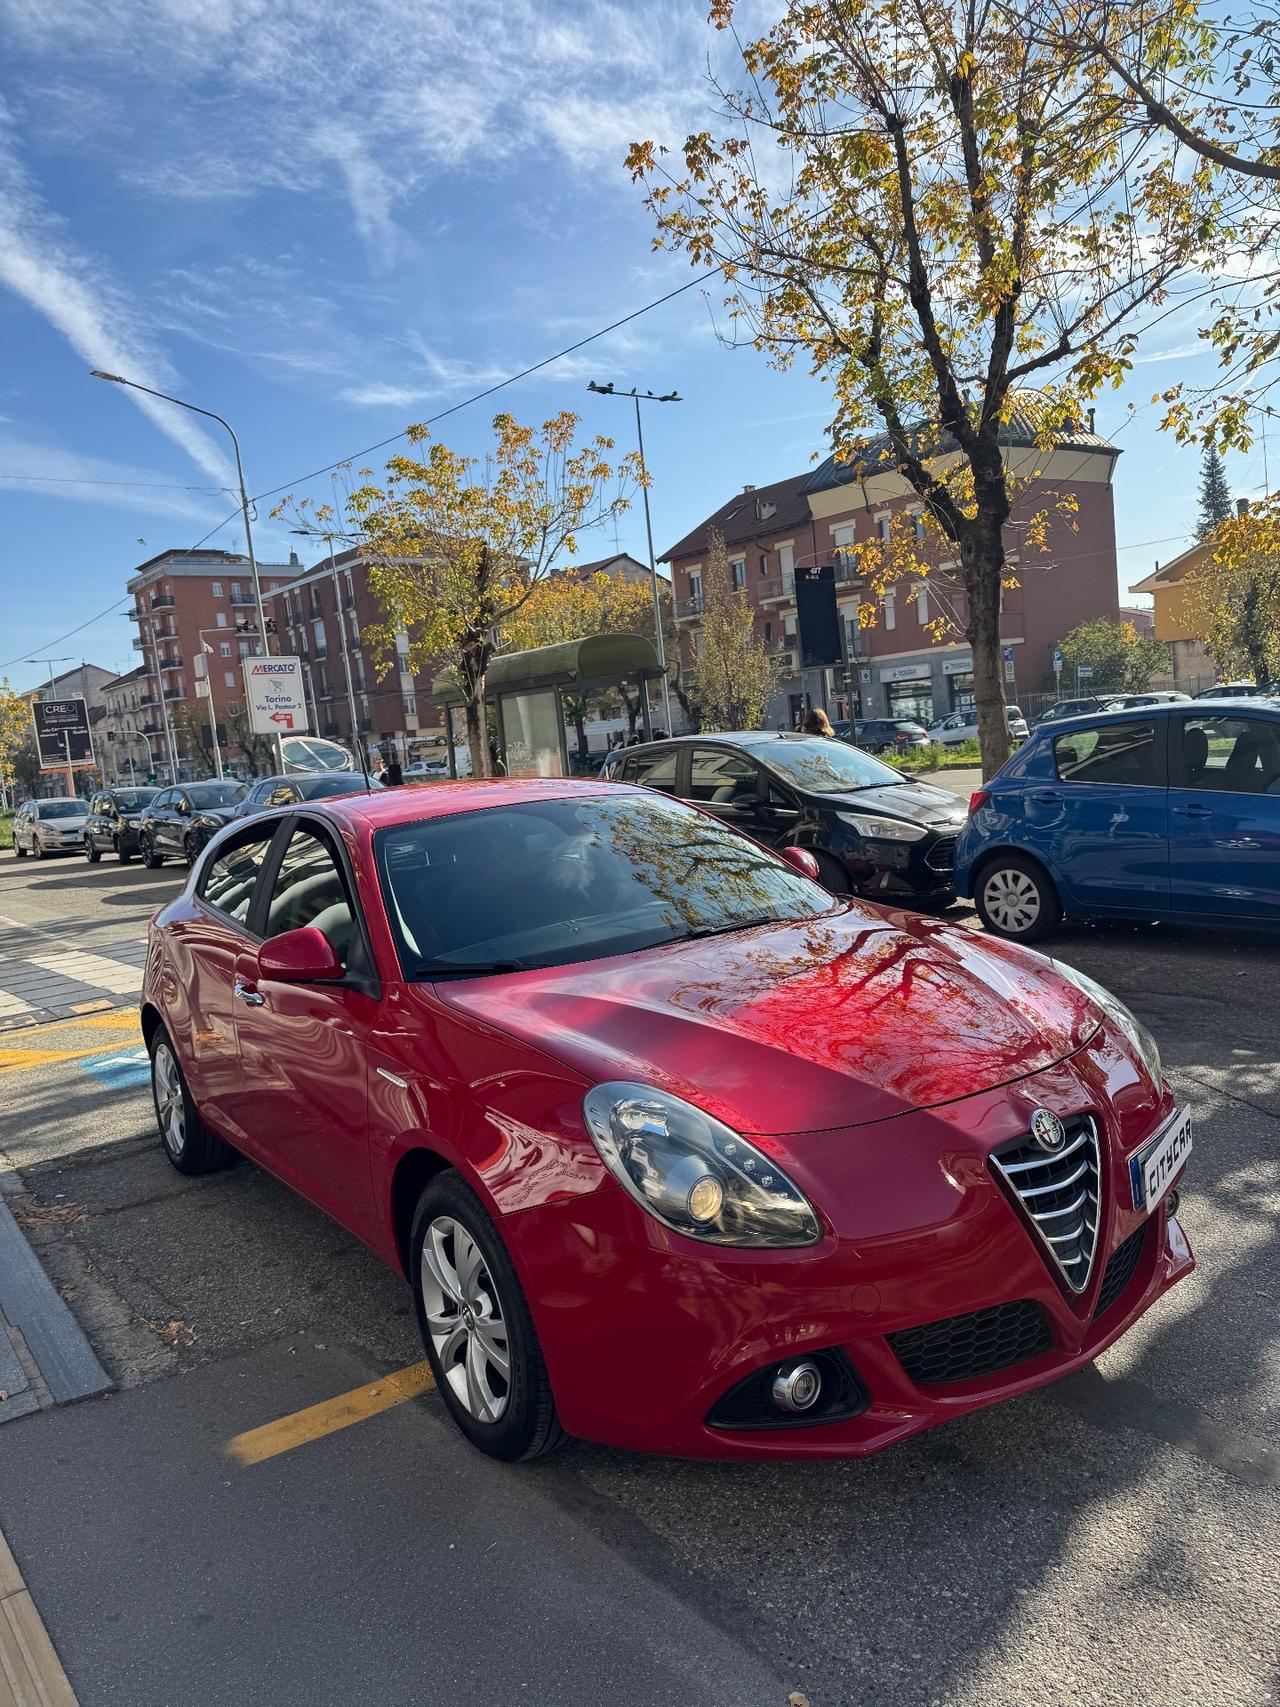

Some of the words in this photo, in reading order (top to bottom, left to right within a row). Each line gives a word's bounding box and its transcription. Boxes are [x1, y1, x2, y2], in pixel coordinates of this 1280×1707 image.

[265, 695, 292, 703] Torino
[45, 704, 75, 714] CREO
[1149, 1118, 1192, 1198] CITYCAR
